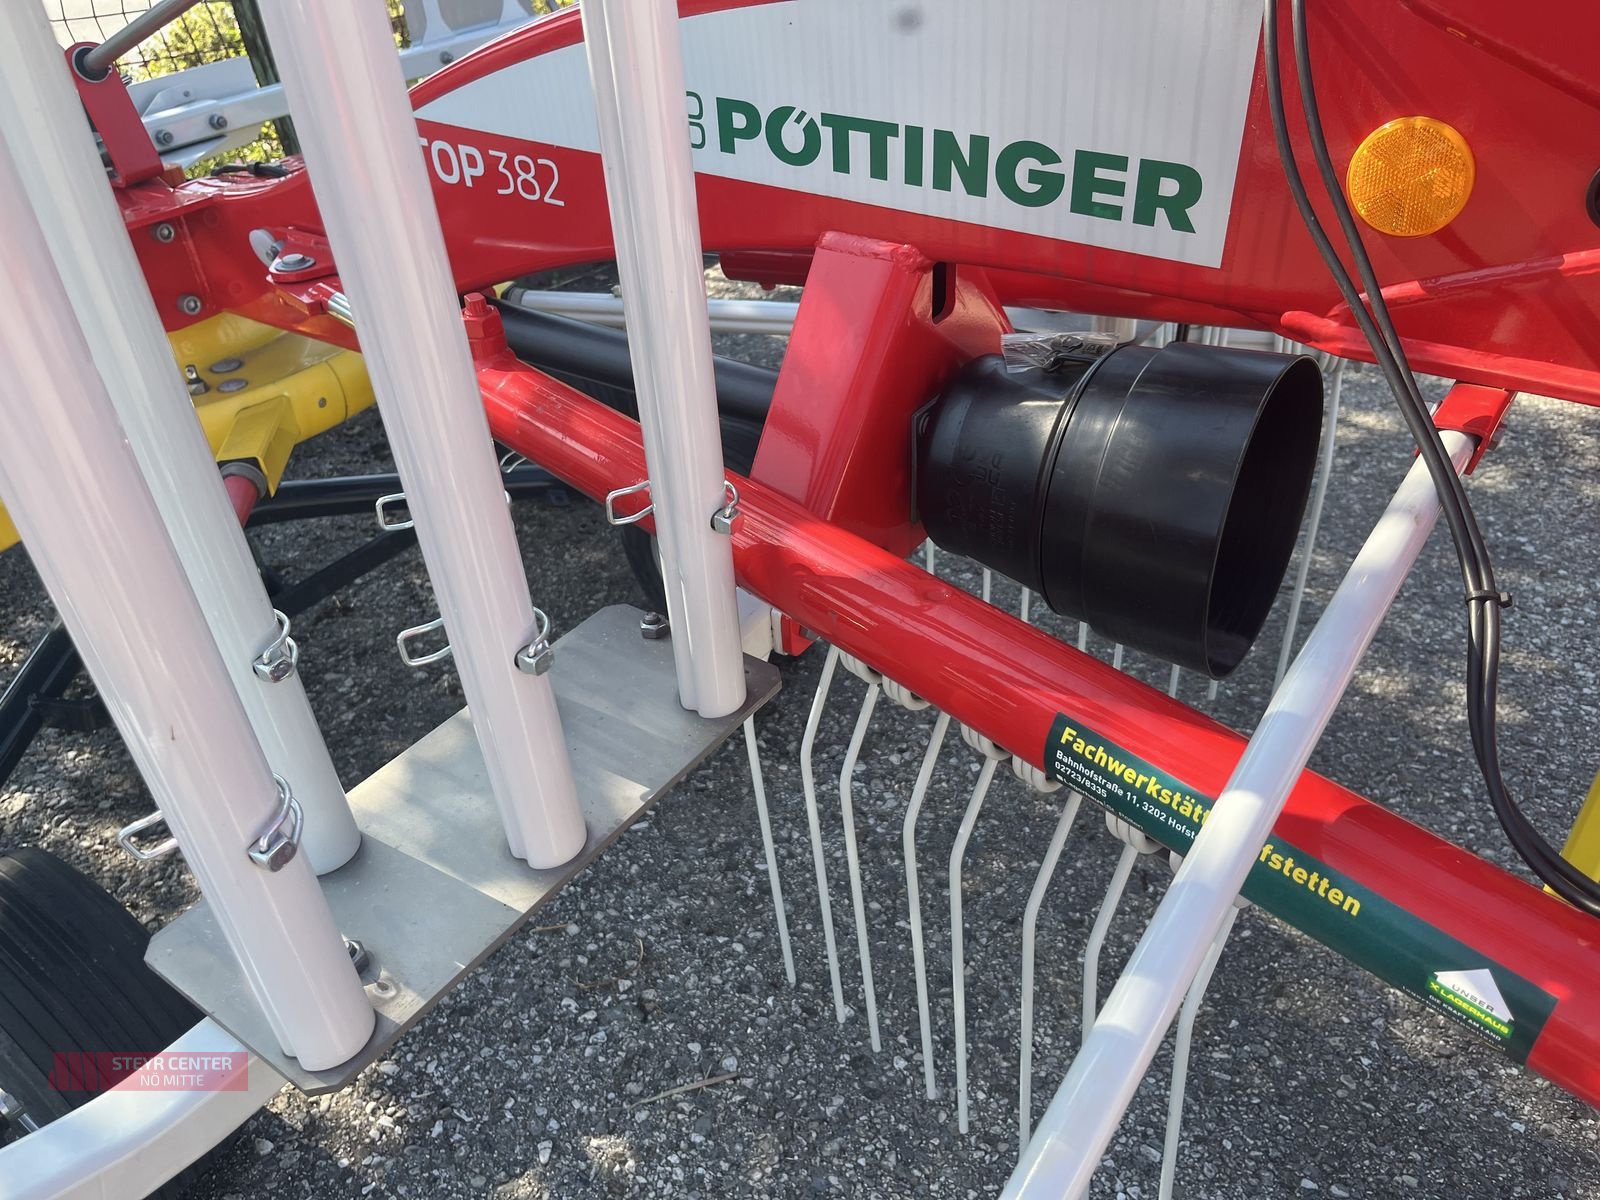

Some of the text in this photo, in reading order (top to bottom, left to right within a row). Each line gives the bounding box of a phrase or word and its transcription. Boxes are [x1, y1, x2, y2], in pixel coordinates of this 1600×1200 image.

[488, 149, 565, 207] 382
[715, 96, 1204, 234] PÖTTINGER
[1054, 761, 1108, 798] 02723/8335
[1056, 749, 1124, 797] Bahnhofstraße
[1141, 801, 1168, 822] 3202
[1168, 816, 1198, 840] Hofst
[1440, 988, 1510, 1035] LAGERHAUS
[1452, 983, 1495, 1014] UNSER
